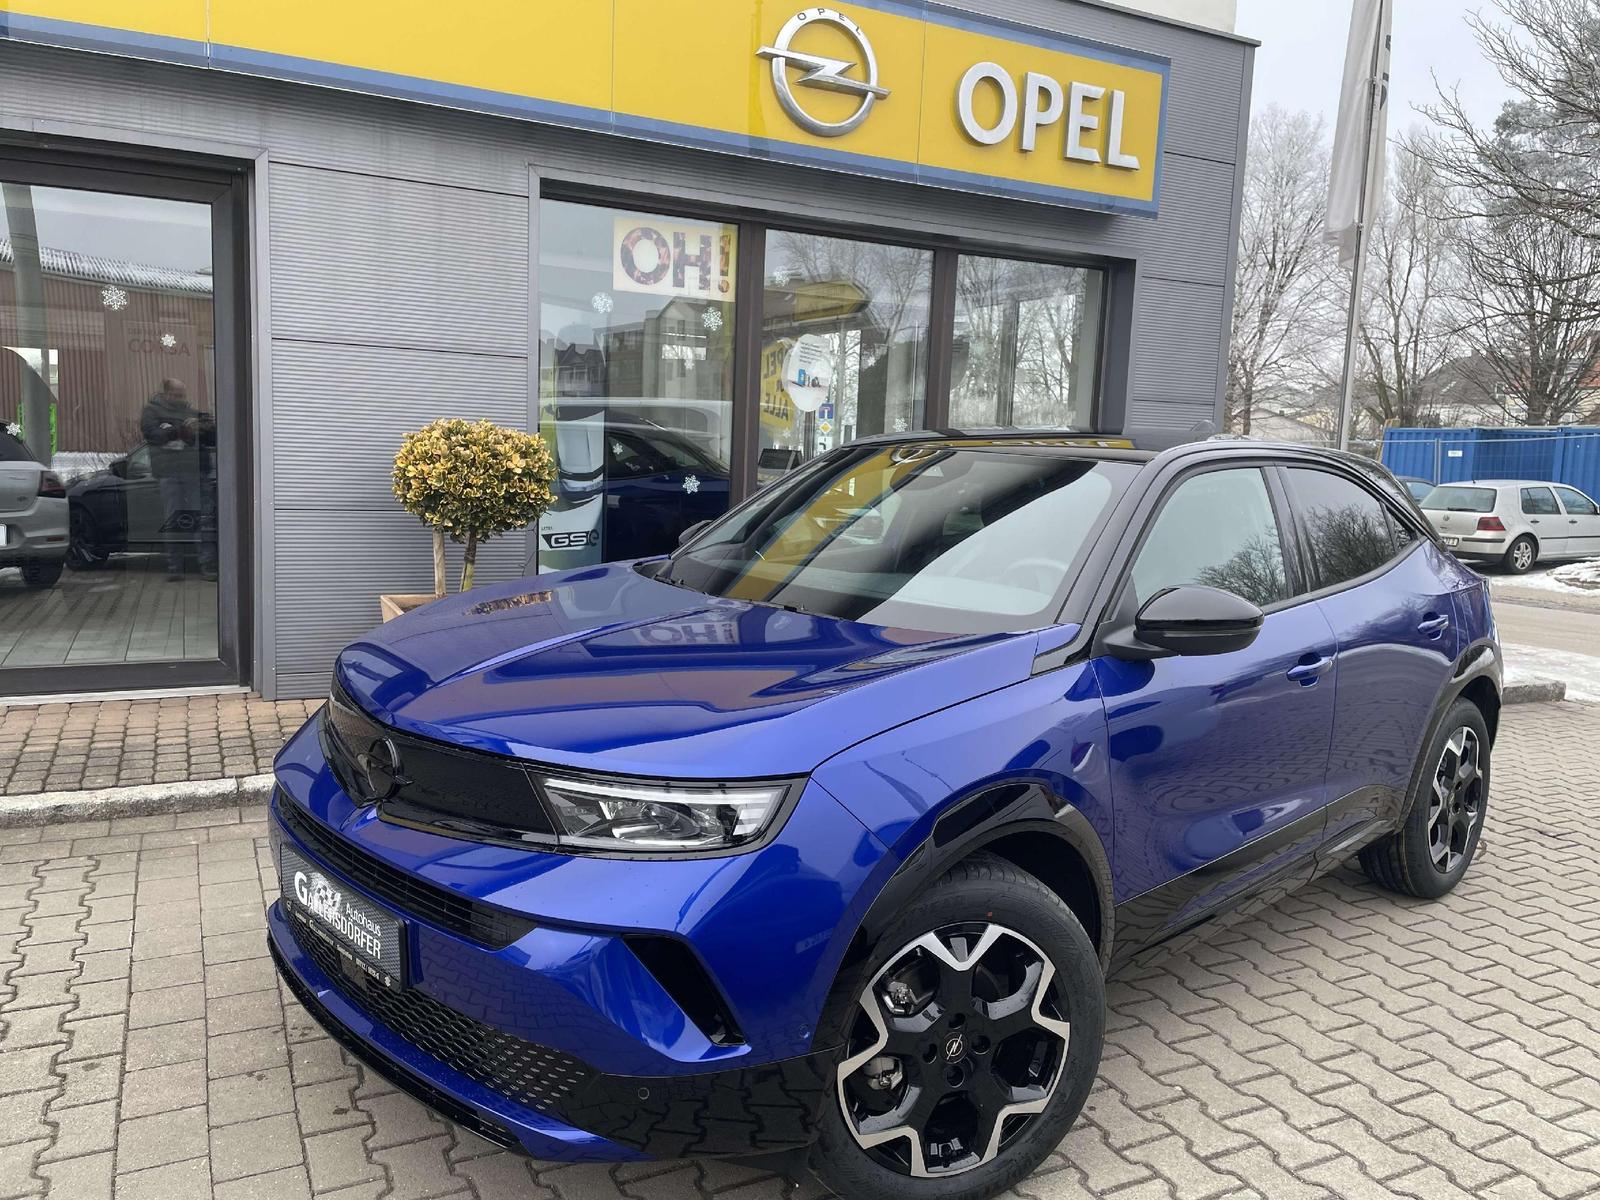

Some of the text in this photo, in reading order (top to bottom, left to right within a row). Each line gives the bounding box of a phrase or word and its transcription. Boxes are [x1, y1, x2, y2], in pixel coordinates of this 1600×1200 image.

[797, 7, 862, 36] OPEL
[956, 61, 1140, 170] OPEL
[620, 226, 731, 293] OH!
[346, 903, 382, 937] Autohaus
